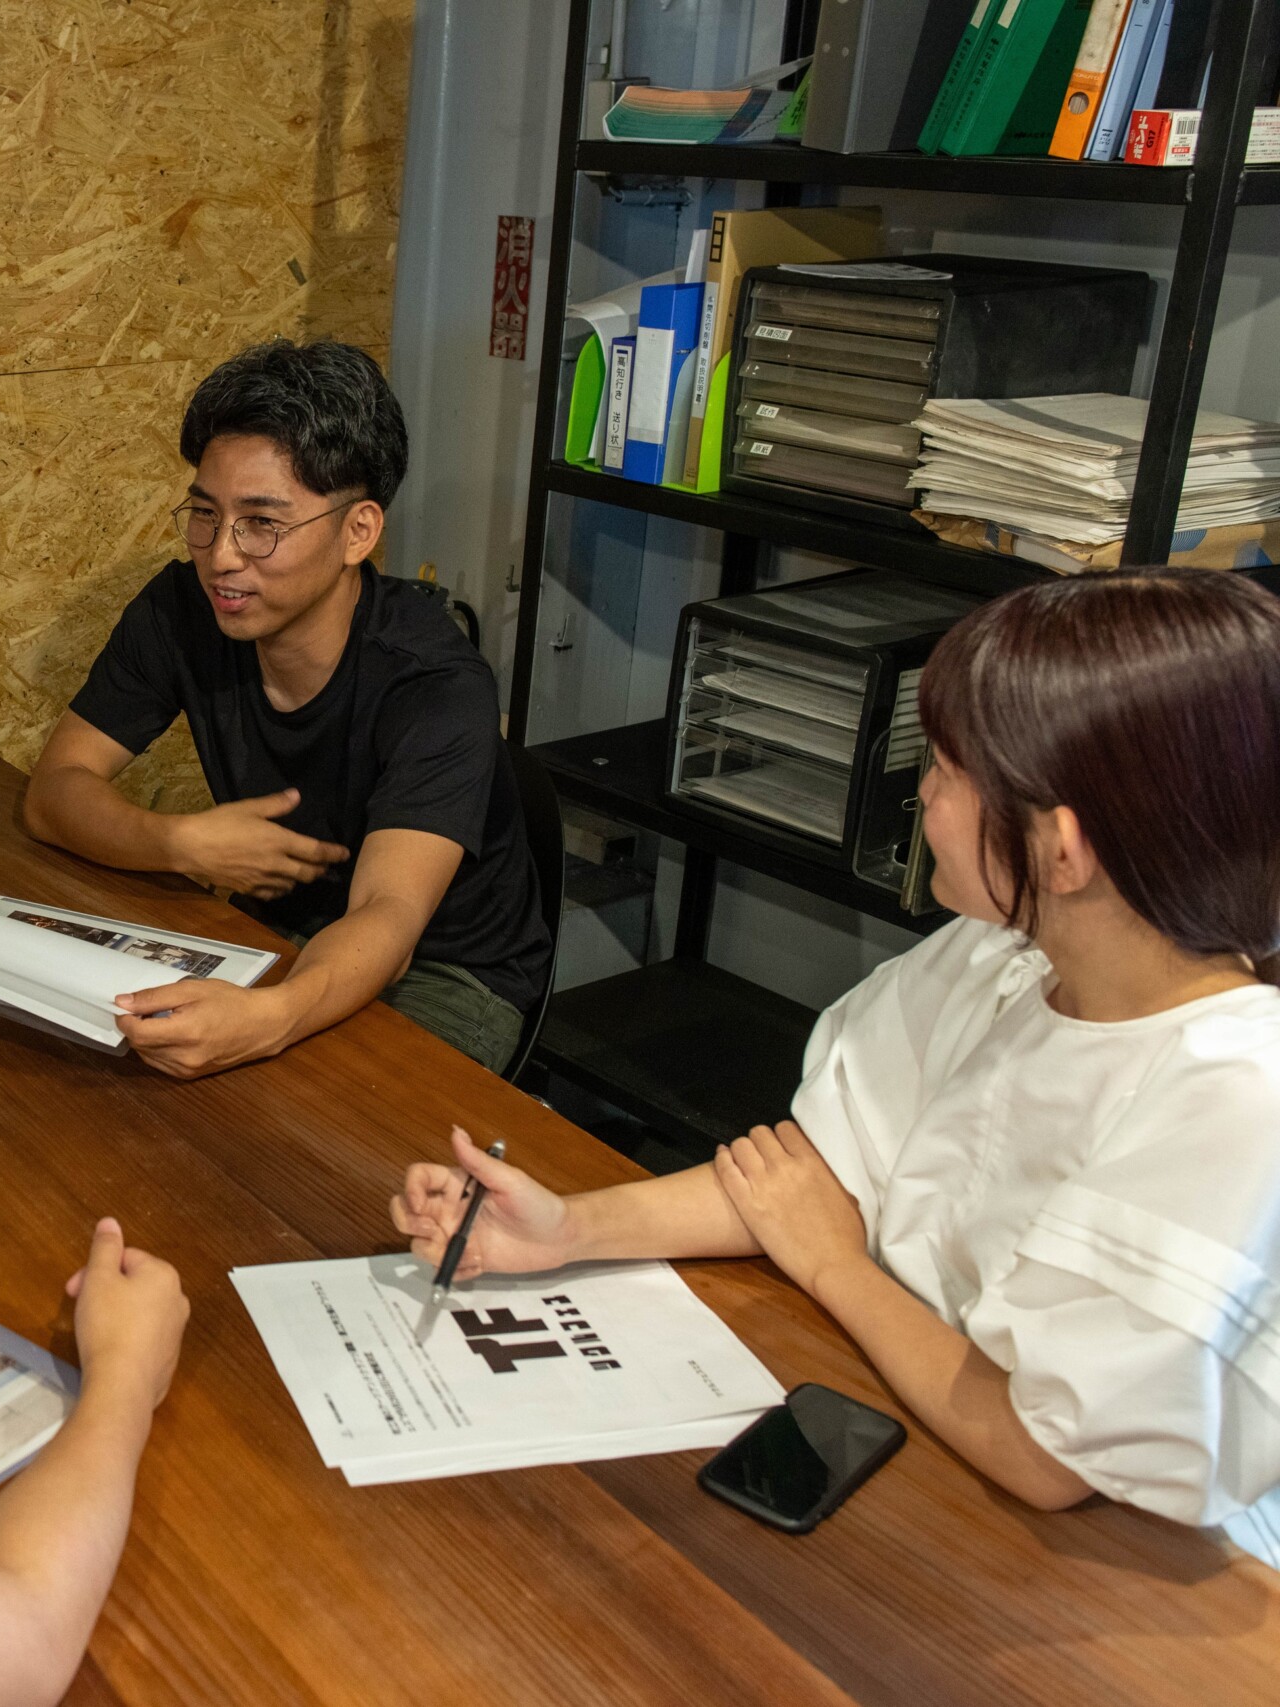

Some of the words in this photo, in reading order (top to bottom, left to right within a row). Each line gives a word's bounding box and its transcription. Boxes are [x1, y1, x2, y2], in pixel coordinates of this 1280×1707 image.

[1133, 116, 1149, 159] ボンド
[1146, 130, 1156, 149] G17
[493, 216, 531, 360] 消火器
[614, 356, 626, 401] 高知行き
[610, 411, 622, 446] 送り状
[451, 1307, 569, 1375] TF
[541, 1294, 623, 1372] ツクルフェス
